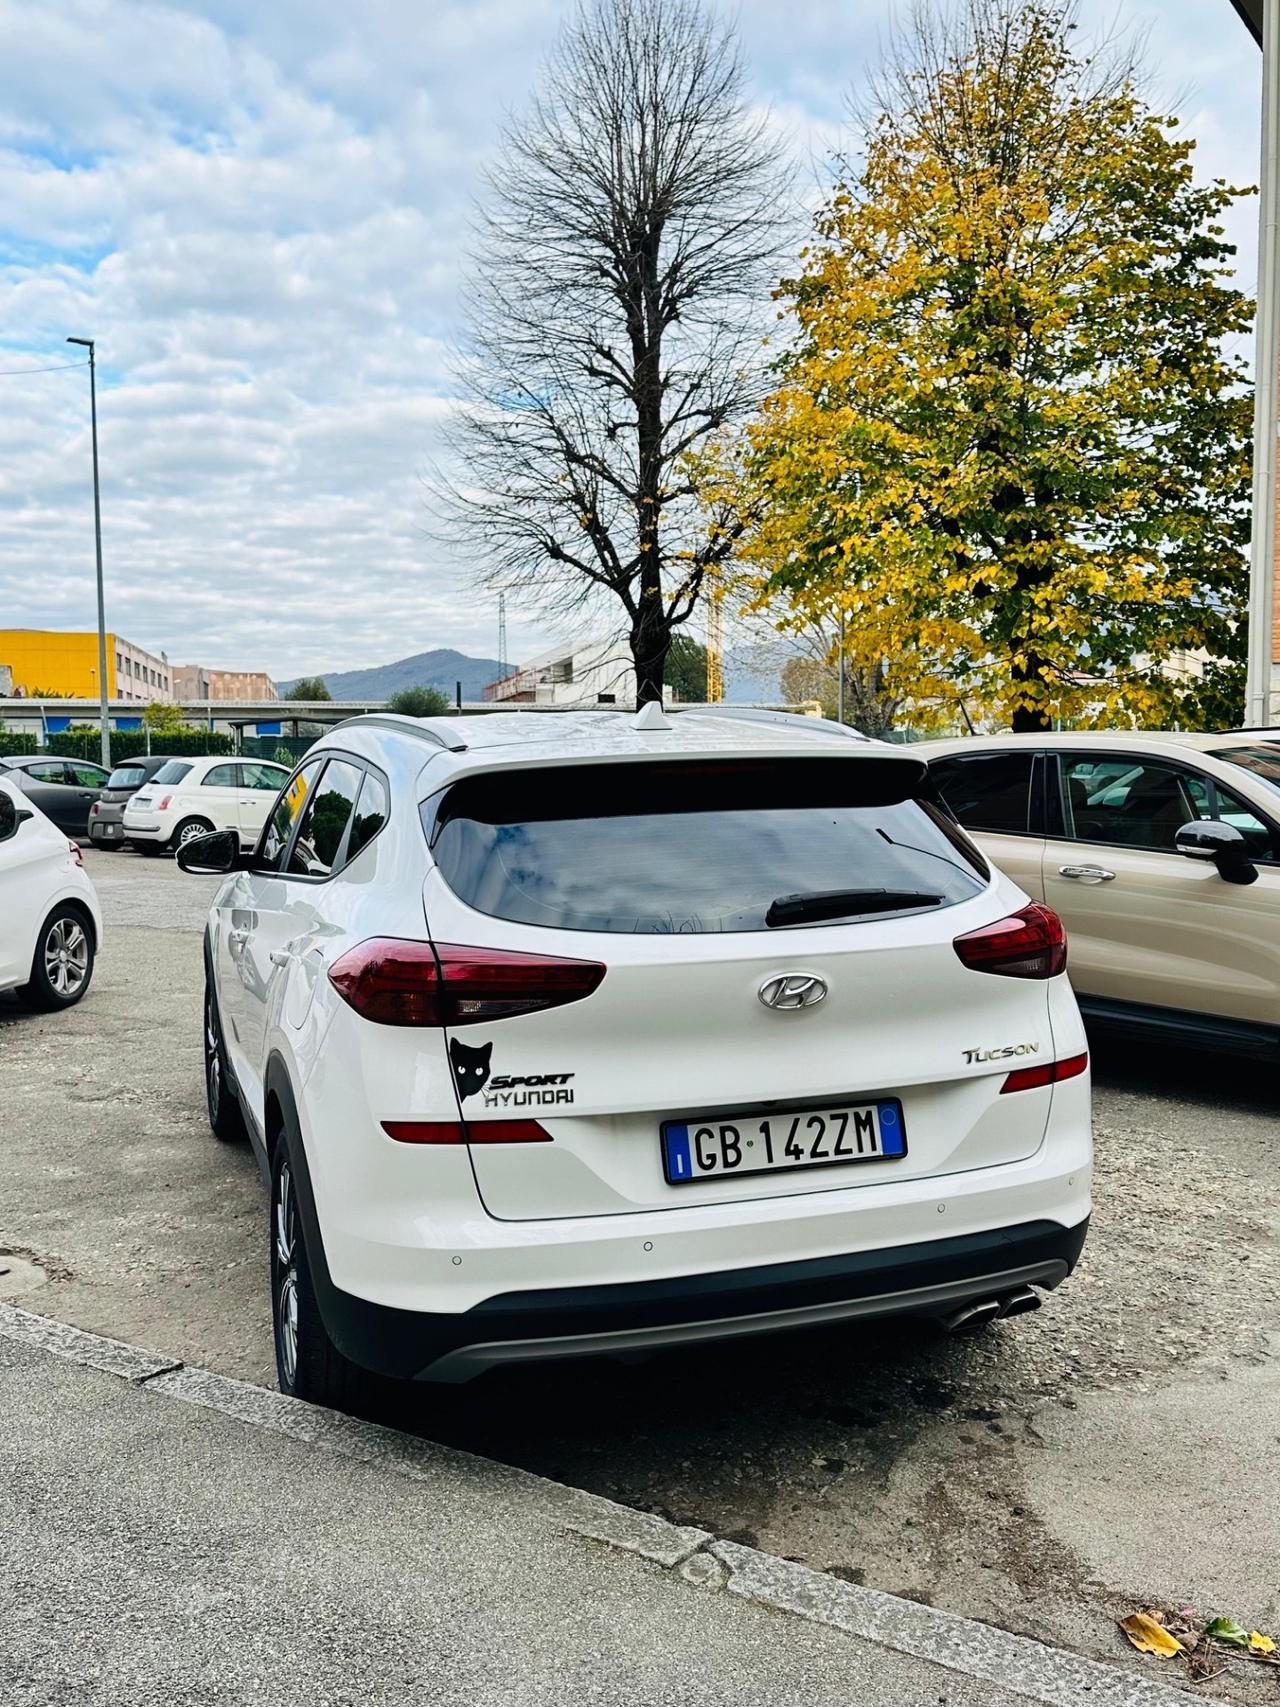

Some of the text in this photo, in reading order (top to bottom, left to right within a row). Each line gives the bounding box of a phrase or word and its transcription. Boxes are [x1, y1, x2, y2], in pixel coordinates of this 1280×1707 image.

[962, 1042, 1039, 1064] TUCSON
[488, 1073, 575, 1090] SPORT
[484, 1089, 574, 1107] HYUNDAI
